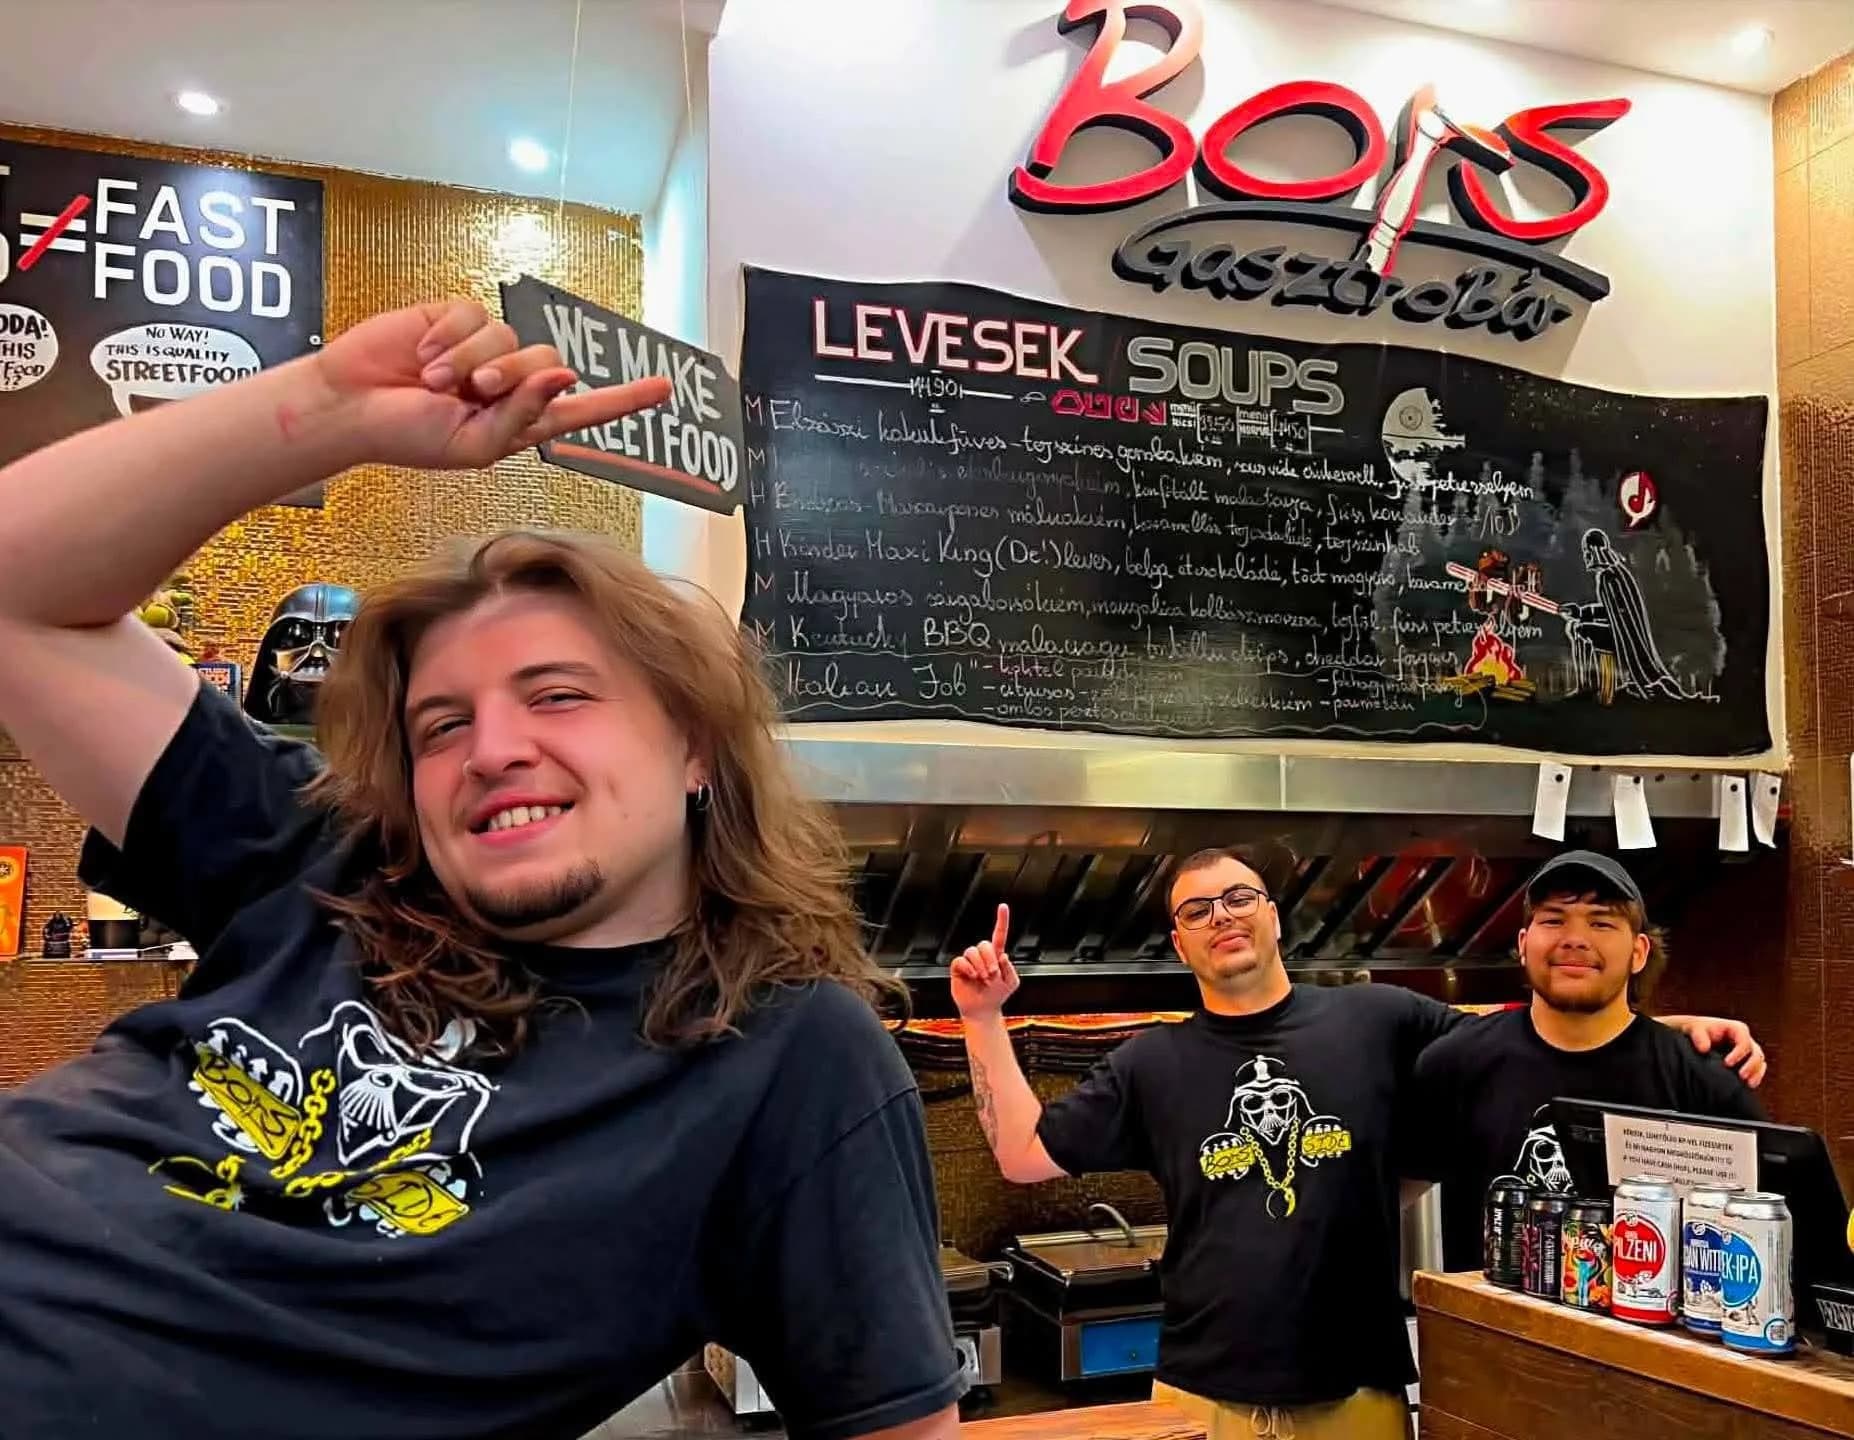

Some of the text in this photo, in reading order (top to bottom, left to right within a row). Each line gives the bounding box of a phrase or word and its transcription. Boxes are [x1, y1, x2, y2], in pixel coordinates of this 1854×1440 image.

[95, 178, 295, 255] FAST
[95, 242, 291, 318] FOOD
[0, 313, 49, 340] ODA!
[146, 327, 208, 345] NO WAY!
[0, 360, 45, 378] FOOD
[105, 344, 229, 363] THIS IS QUALITY
[543, 304, 722, 423] WE MAKE
[812, 296, 1099, 385] LEVESEK
[1127, 336, 1345, 416] SOUPS
[937, 528, 993, 578] King
[922, 617, 990, 650] BBQ
